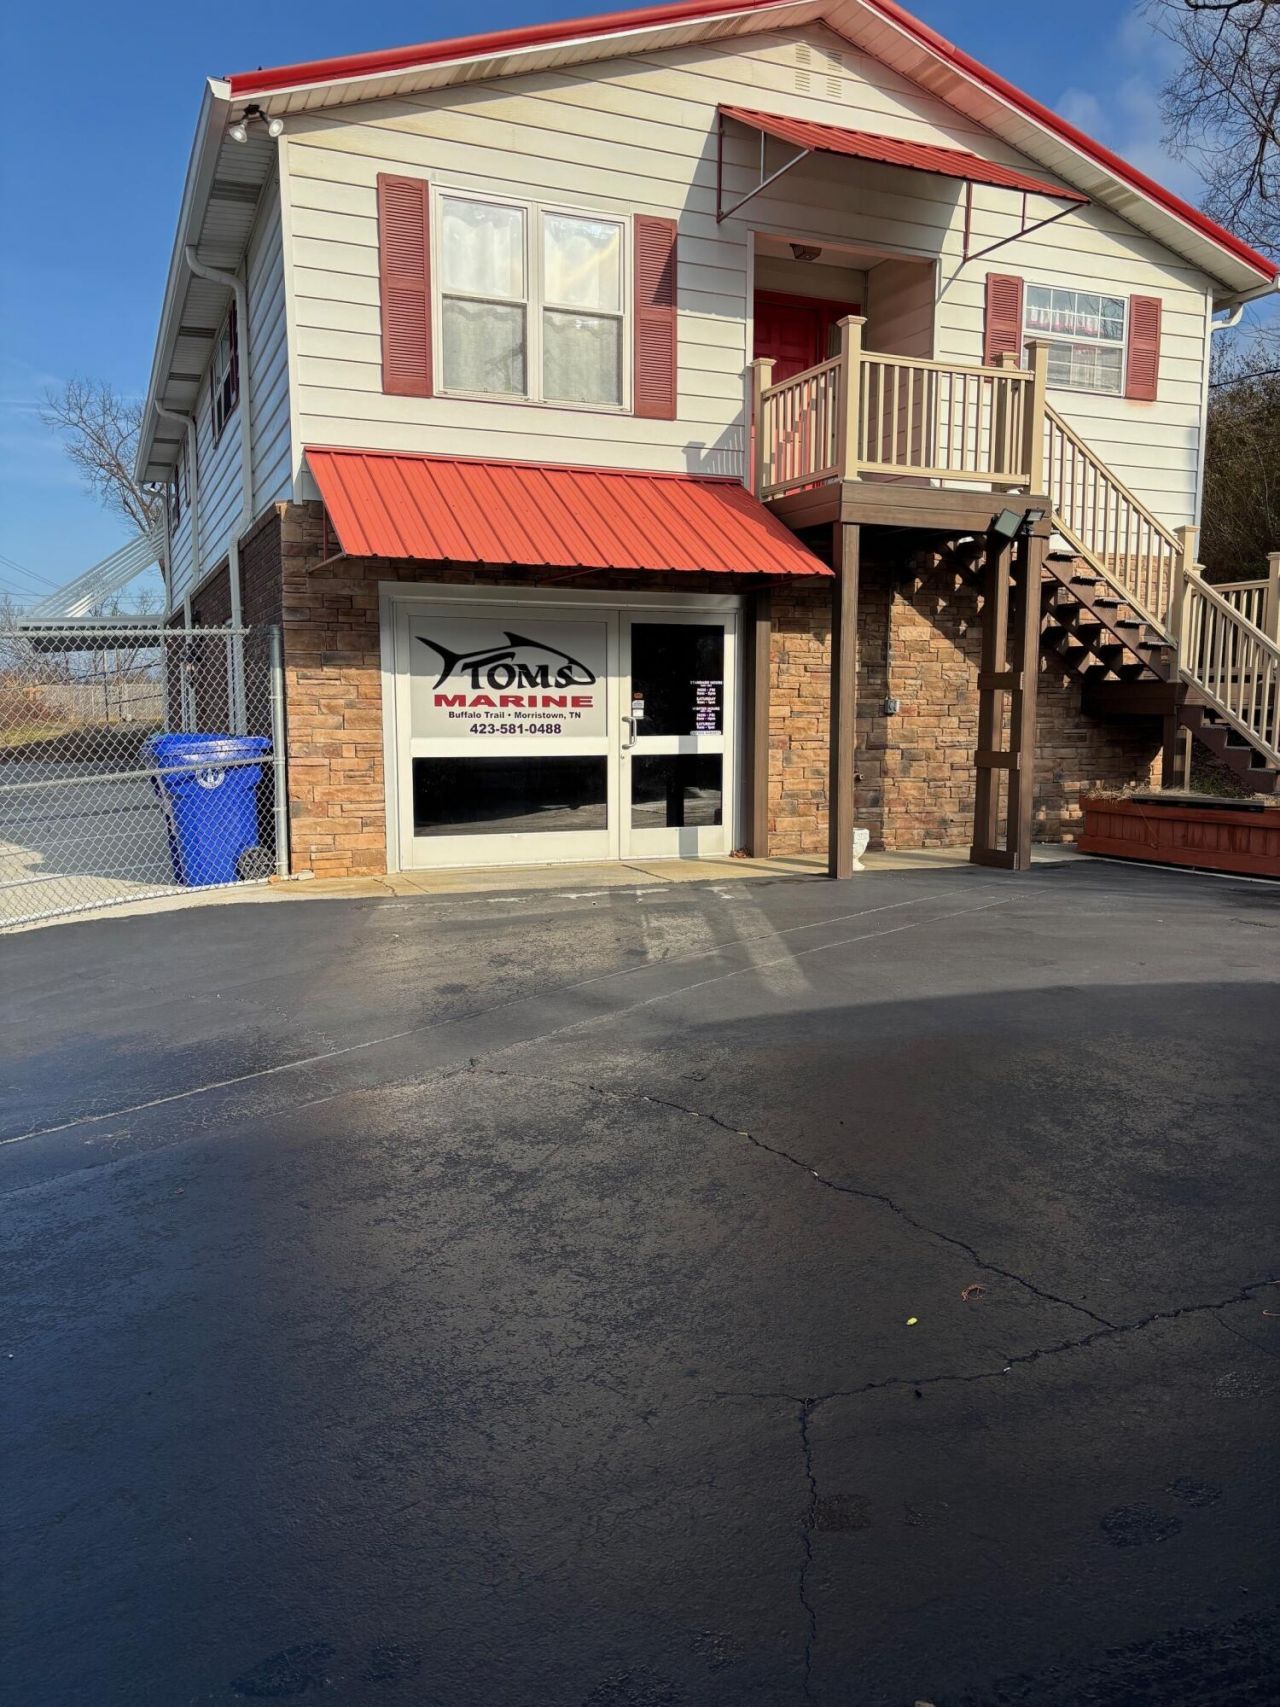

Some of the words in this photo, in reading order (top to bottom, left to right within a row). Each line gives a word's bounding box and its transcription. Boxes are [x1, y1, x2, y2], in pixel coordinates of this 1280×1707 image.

[461, 652, 573, 690] TOMS
[434, 694, 594, 708] MARINE
[448, 711, 482, 719] Buffalo
[484, 711, 505, 719] Trail
[514, 711, 567, 720] Morristown,
[569, 711, 581, 719] TN
[469, 723, 562, 735] 423-581-0488
